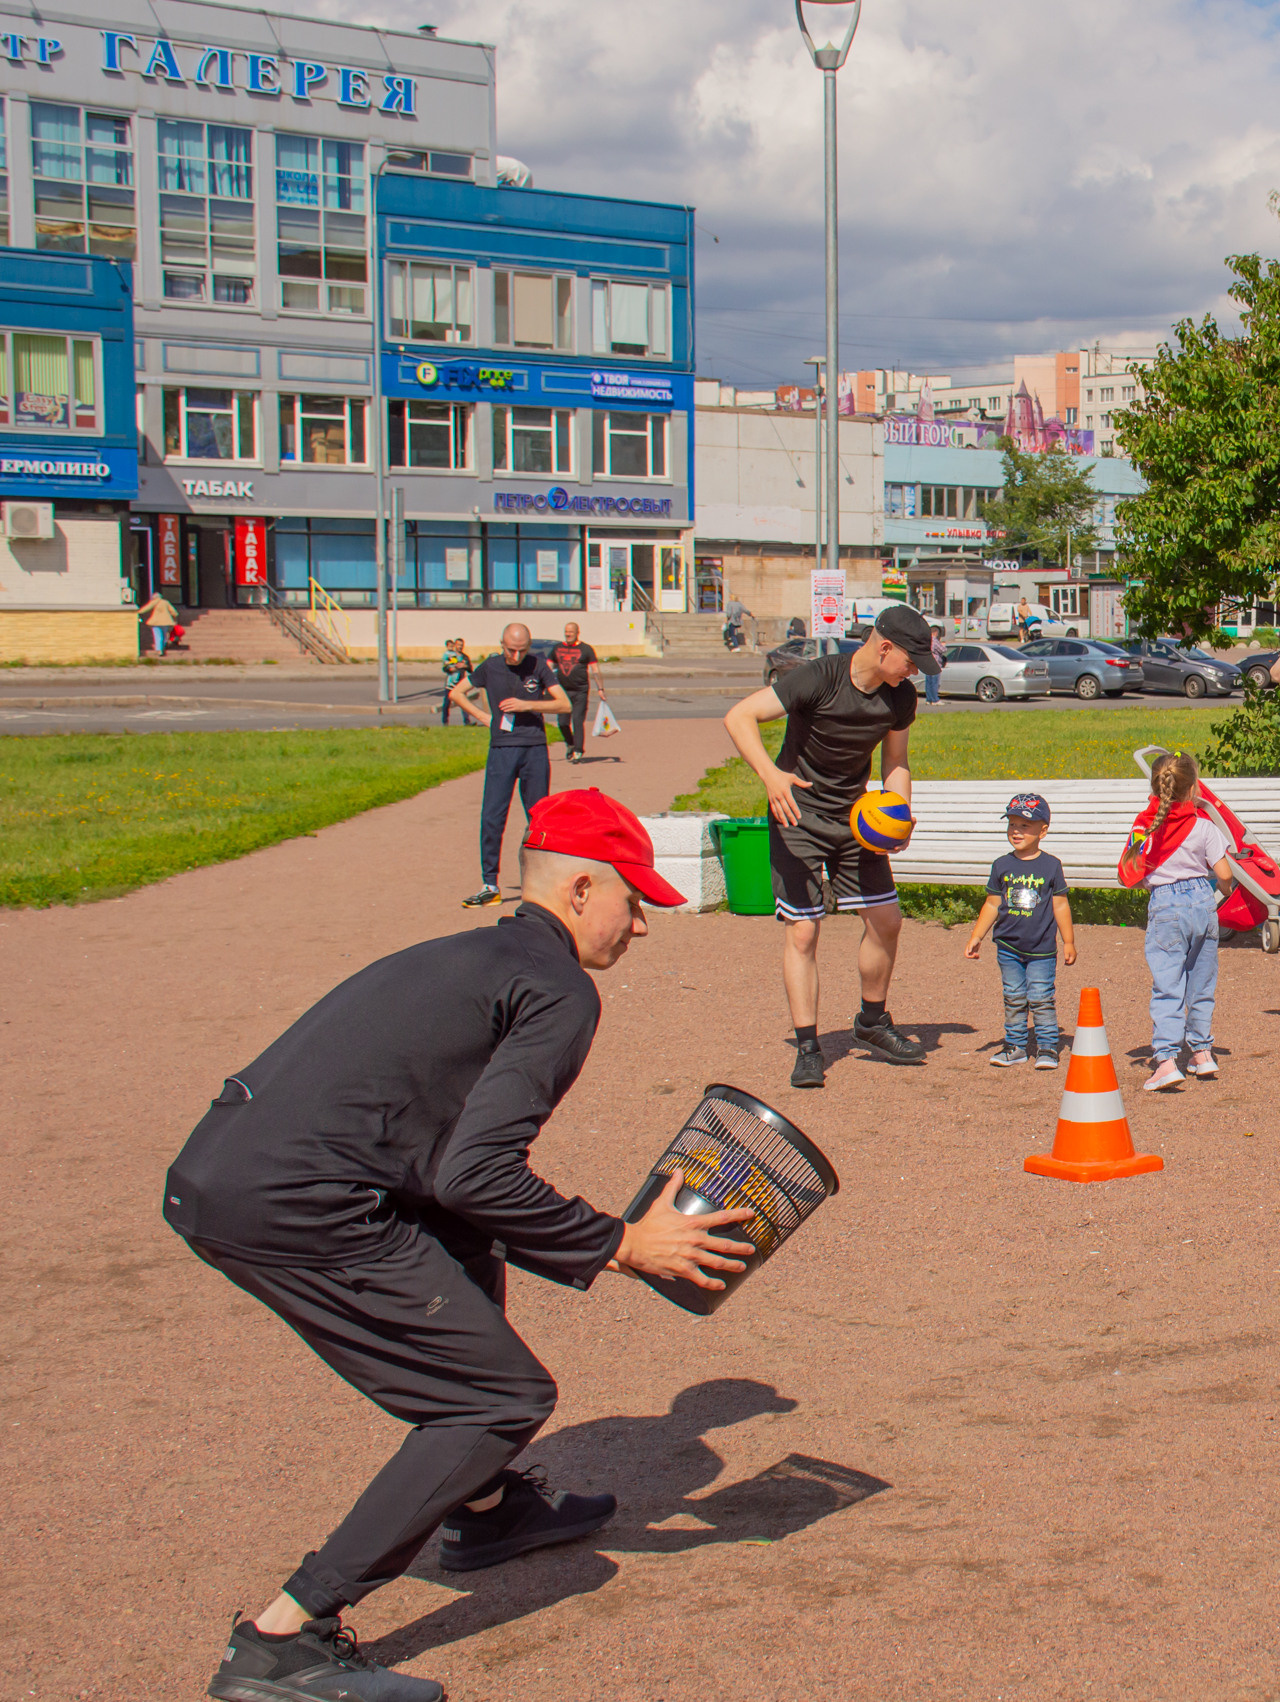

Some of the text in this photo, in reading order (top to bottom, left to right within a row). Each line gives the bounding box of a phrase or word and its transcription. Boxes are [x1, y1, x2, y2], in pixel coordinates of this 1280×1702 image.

[1, 30, 417, 116] ТР ГАЛЕРЕЯ
[603, 373, 629, 386] ТВОЯ
[592, 385, 673, 401] НЕДВИЖИМОСТЬ
[0, 458, 111, 477] ЕРМОЛИНО
[182, 479, 254, 498] ТАБАК
[163, 517, 177, 582] ТАБАК
[244, 519, 259, 583] ТАБАК
